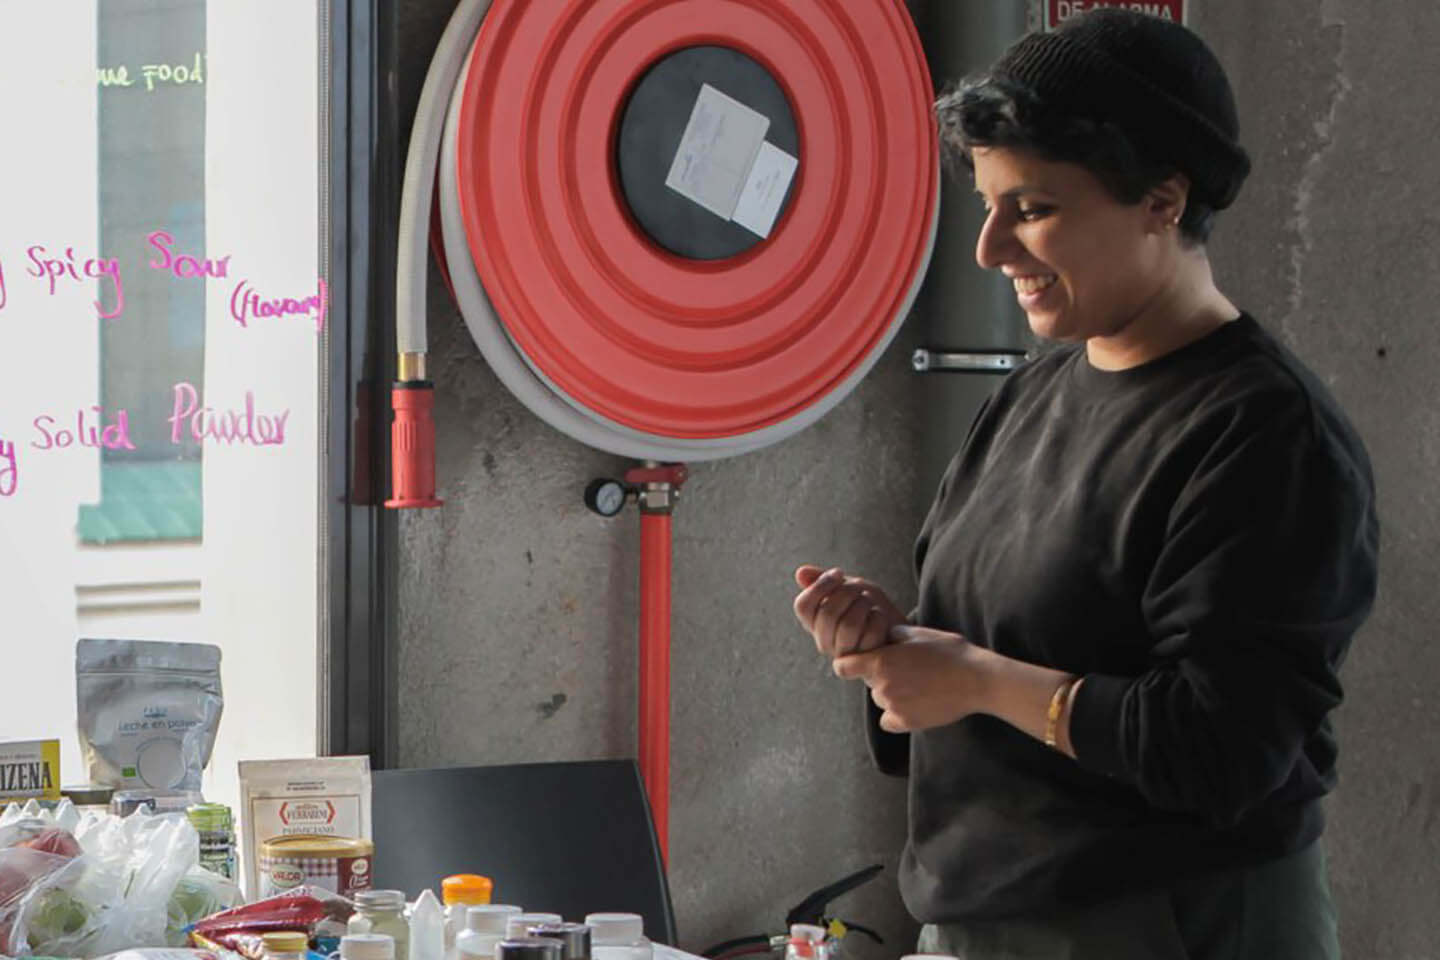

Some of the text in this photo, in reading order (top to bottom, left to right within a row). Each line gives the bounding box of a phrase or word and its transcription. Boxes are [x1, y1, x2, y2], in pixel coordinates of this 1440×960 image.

[1057, 0, 1173, 22] DE RMA
[141, 51, 205, 92] Food
[26, 244, 125, 319] Spicy
[145, 231, 232, 278] Sour
[31, 405, 137, 450] Solid
